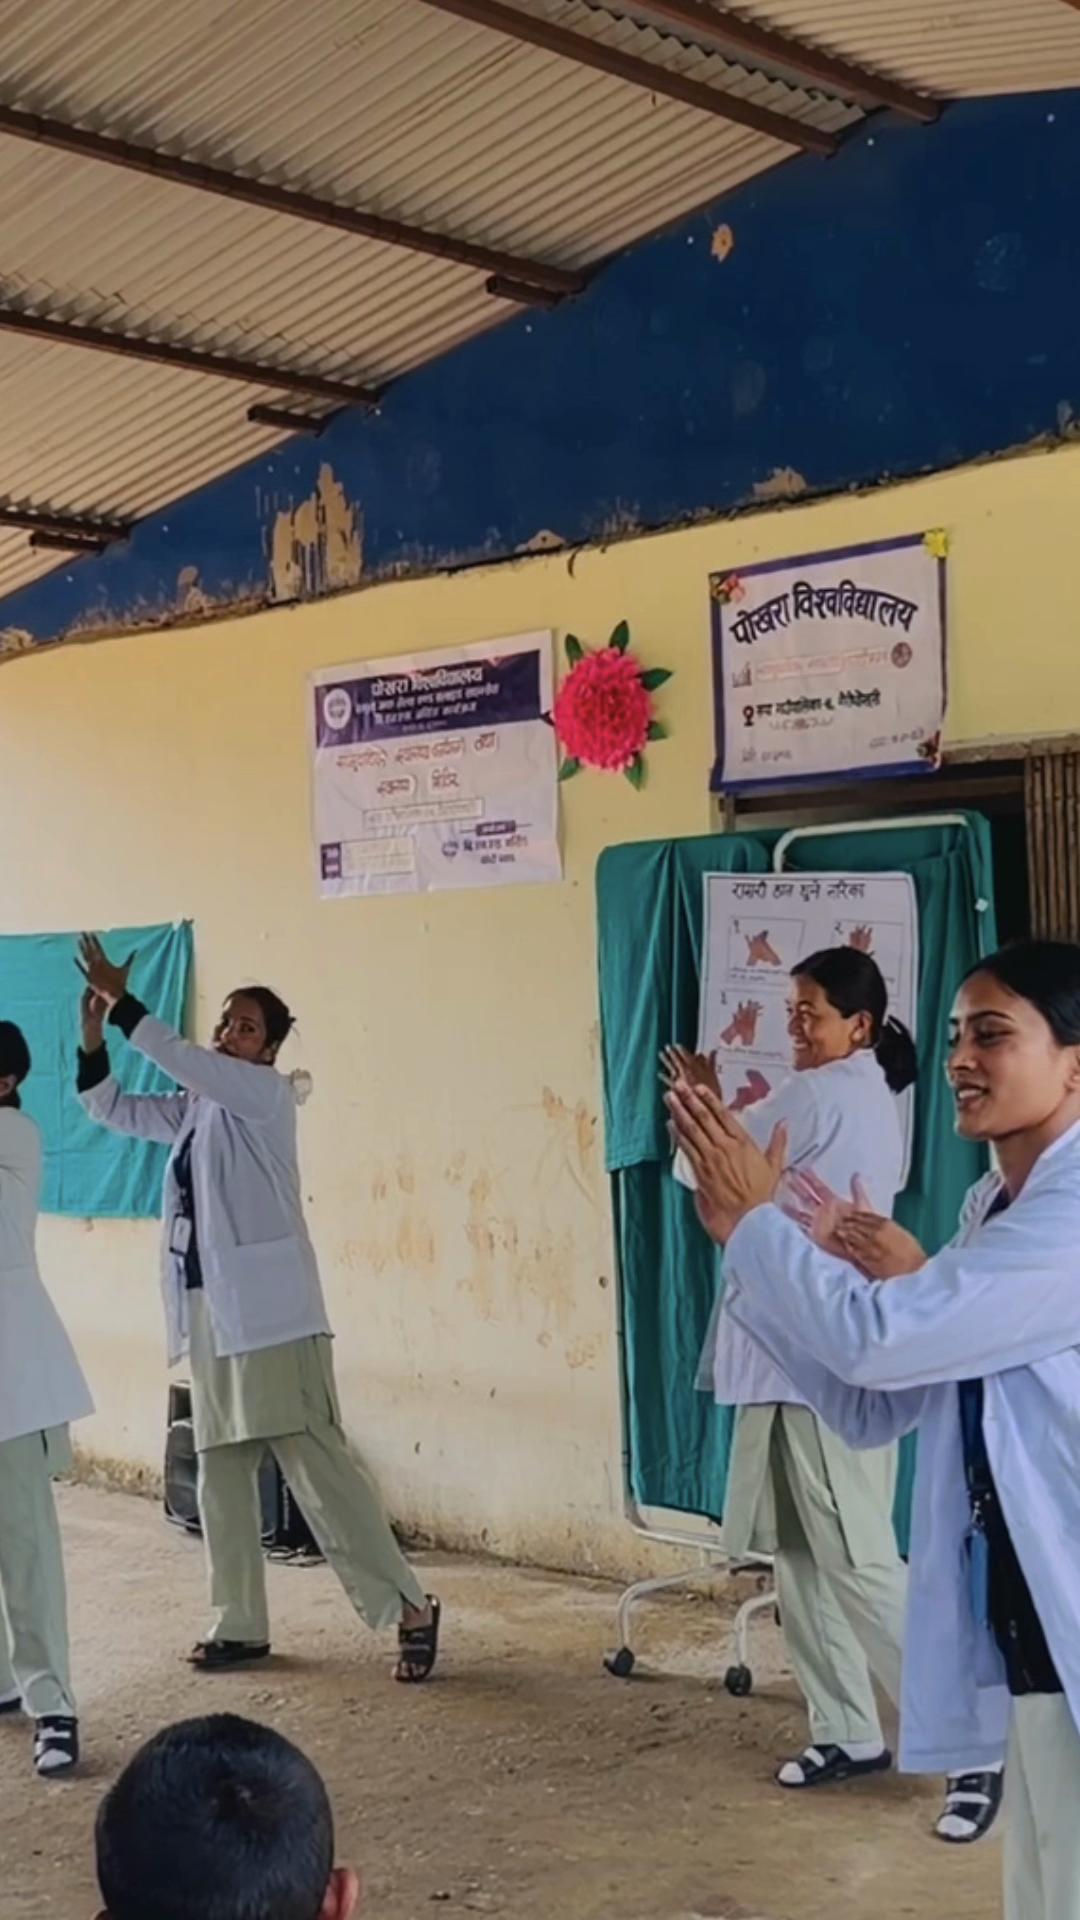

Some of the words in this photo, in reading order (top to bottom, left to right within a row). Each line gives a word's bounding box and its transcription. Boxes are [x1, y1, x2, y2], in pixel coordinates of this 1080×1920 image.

[729, 593, 791, 644] पोखरा
[792, 579, 919, 633] विश्वविद्यालय
[371, 677, 409, 697] पोखरा
